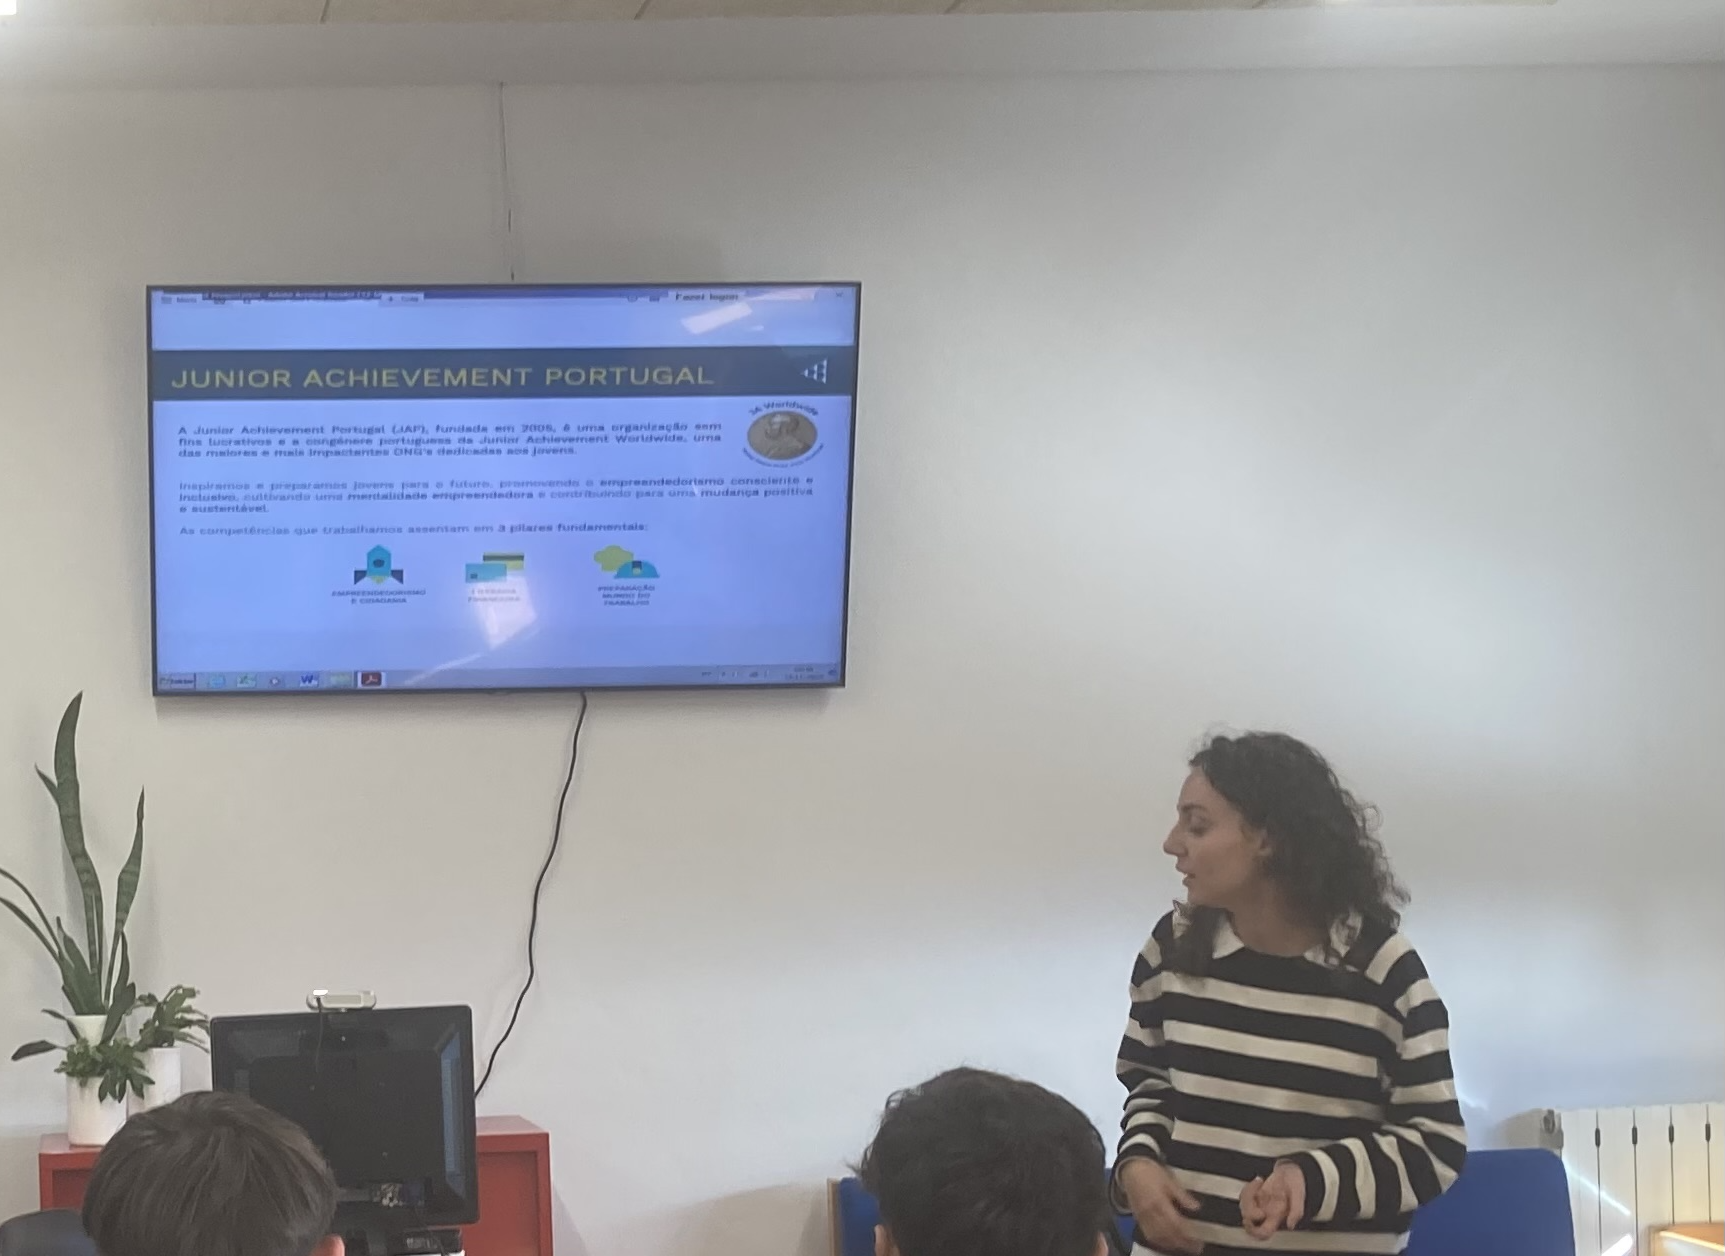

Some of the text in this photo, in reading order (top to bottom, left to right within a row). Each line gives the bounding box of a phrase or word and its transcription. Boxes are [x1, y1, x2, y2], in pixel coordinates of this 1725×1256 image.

[171, 366, 715, 388] JUNIOR ACHIEVEMENT PORTUGAL
[193, 425, 234, 435] Junior
[241, 425, 325, 435] Achievement
[332, 424, 385, 436] Portugal
[435, 423, 488, 434] fundada
[494, 425, 515, 433] em
[577, 424, 605, 433] uma
[611, 421, 688, 434] organização
[694, 422, 722, 432] sem
[178, 437, 202, 447] fins
[208, 437, 273, 447] lucrativos
[379, 436, 452, 448] portuguesa
[457, 436, 474, 446] da
[479, 435, 519, 445] Junior
[526, 434, 610, 444] Achievement
[615, 432, 688, 444] Worldwide,
[693, 433, 723, 443] uma
[178, 448, 202, 458] das
[205, 448, 258, 457] maiores
[274, 448, 305, 457] mais
[309, 447, 390, 459] impactantes
[436, 446, 502, 457] dedicadas
[506, 446, 529, 456] aos
[179, 481, 251, 491] Inspiramos
[270, 482, 348, 492] preparamos
[353, 480, 395, 491] jovens
[401, 481, 429, 491] para
[499, 479, 580, 490] promovendo
[599, 477, 725, 489] empreendedorismo
[730, 475, 800, 486] consciente
[347, 491, 428, 501] mentalidade
[432, 490, 534, 502] empreendedora
[550, 489, 632, 499] contribuindo
[635, 489, 664, 500] para
[700, 488, 760, 499] mudança
[763, 486, 814, 498] positiva
[180, 526, 195, 536] As
[199, 525, 292, 537] competências
[294, 527, 318, 537] que
[322, 524, 404, 536] trabalhamos
[407, 525, 470, 535] assentam
[473, 525, 494, 534] em
[509, 522, 553, 534] pilares
